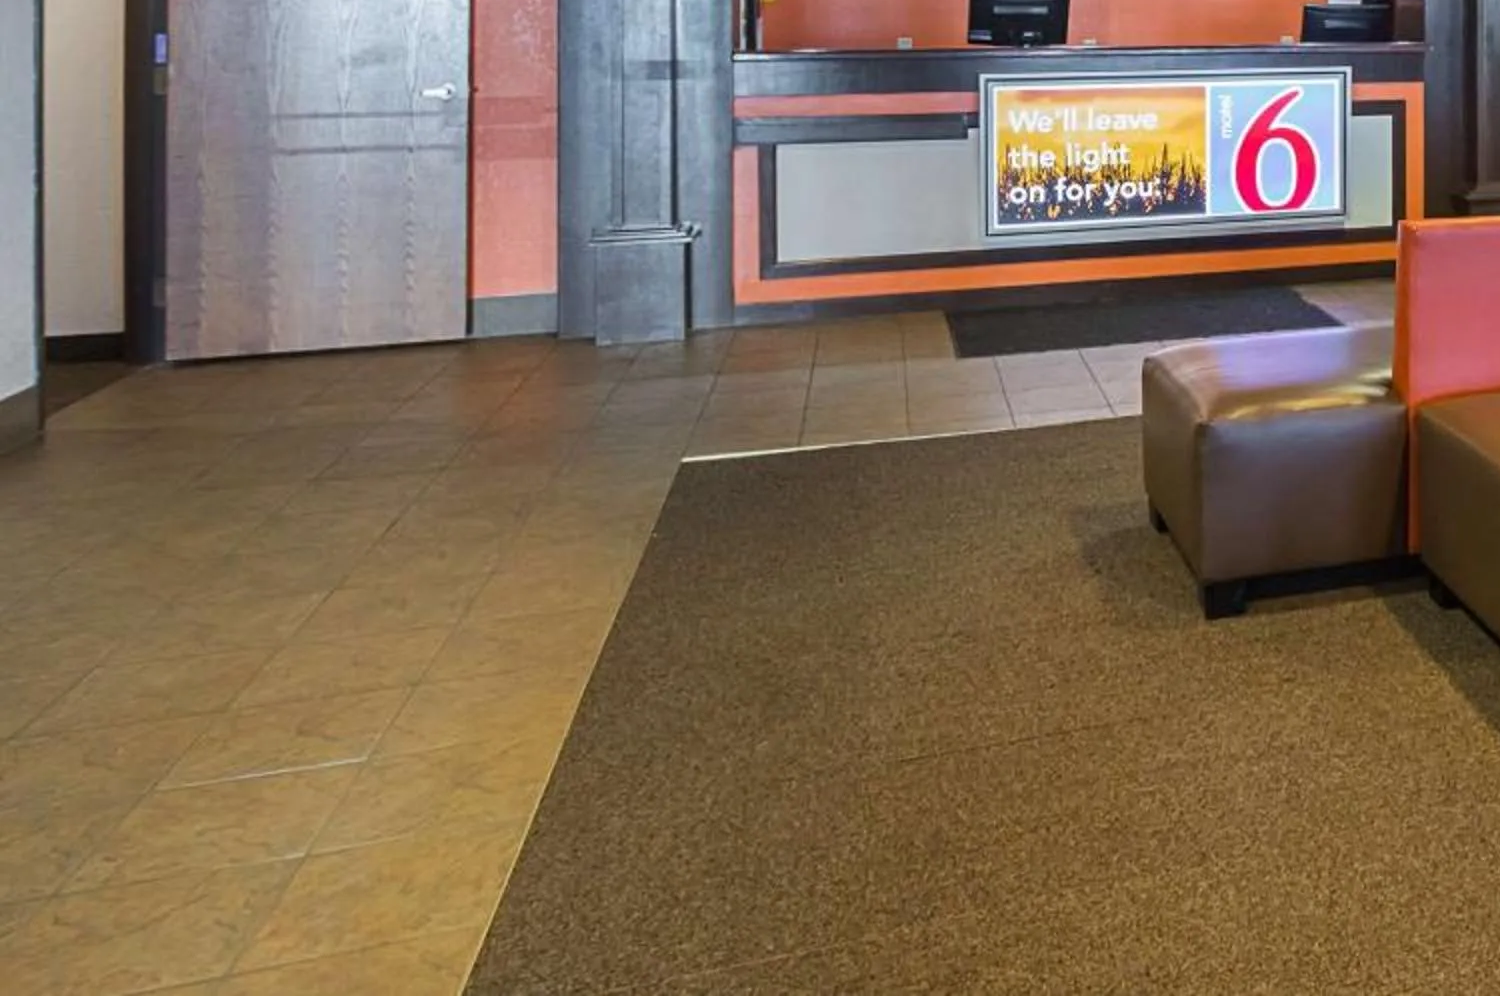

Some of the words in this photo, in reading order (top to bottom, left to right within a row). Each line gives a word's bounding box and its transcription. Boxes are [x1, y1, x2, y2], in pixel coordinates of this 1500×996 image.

[1008, 107, 1077, 133] We'll
[1088, 107, 1158, 130] leave
[1008, 143, 1056, 169] the
[1066, 141, 1131, 173] light
[1231, 86, 1320, 214] 6
[1010, 186, 1045, 204] on
[1055, 176, 1096, 202] for
